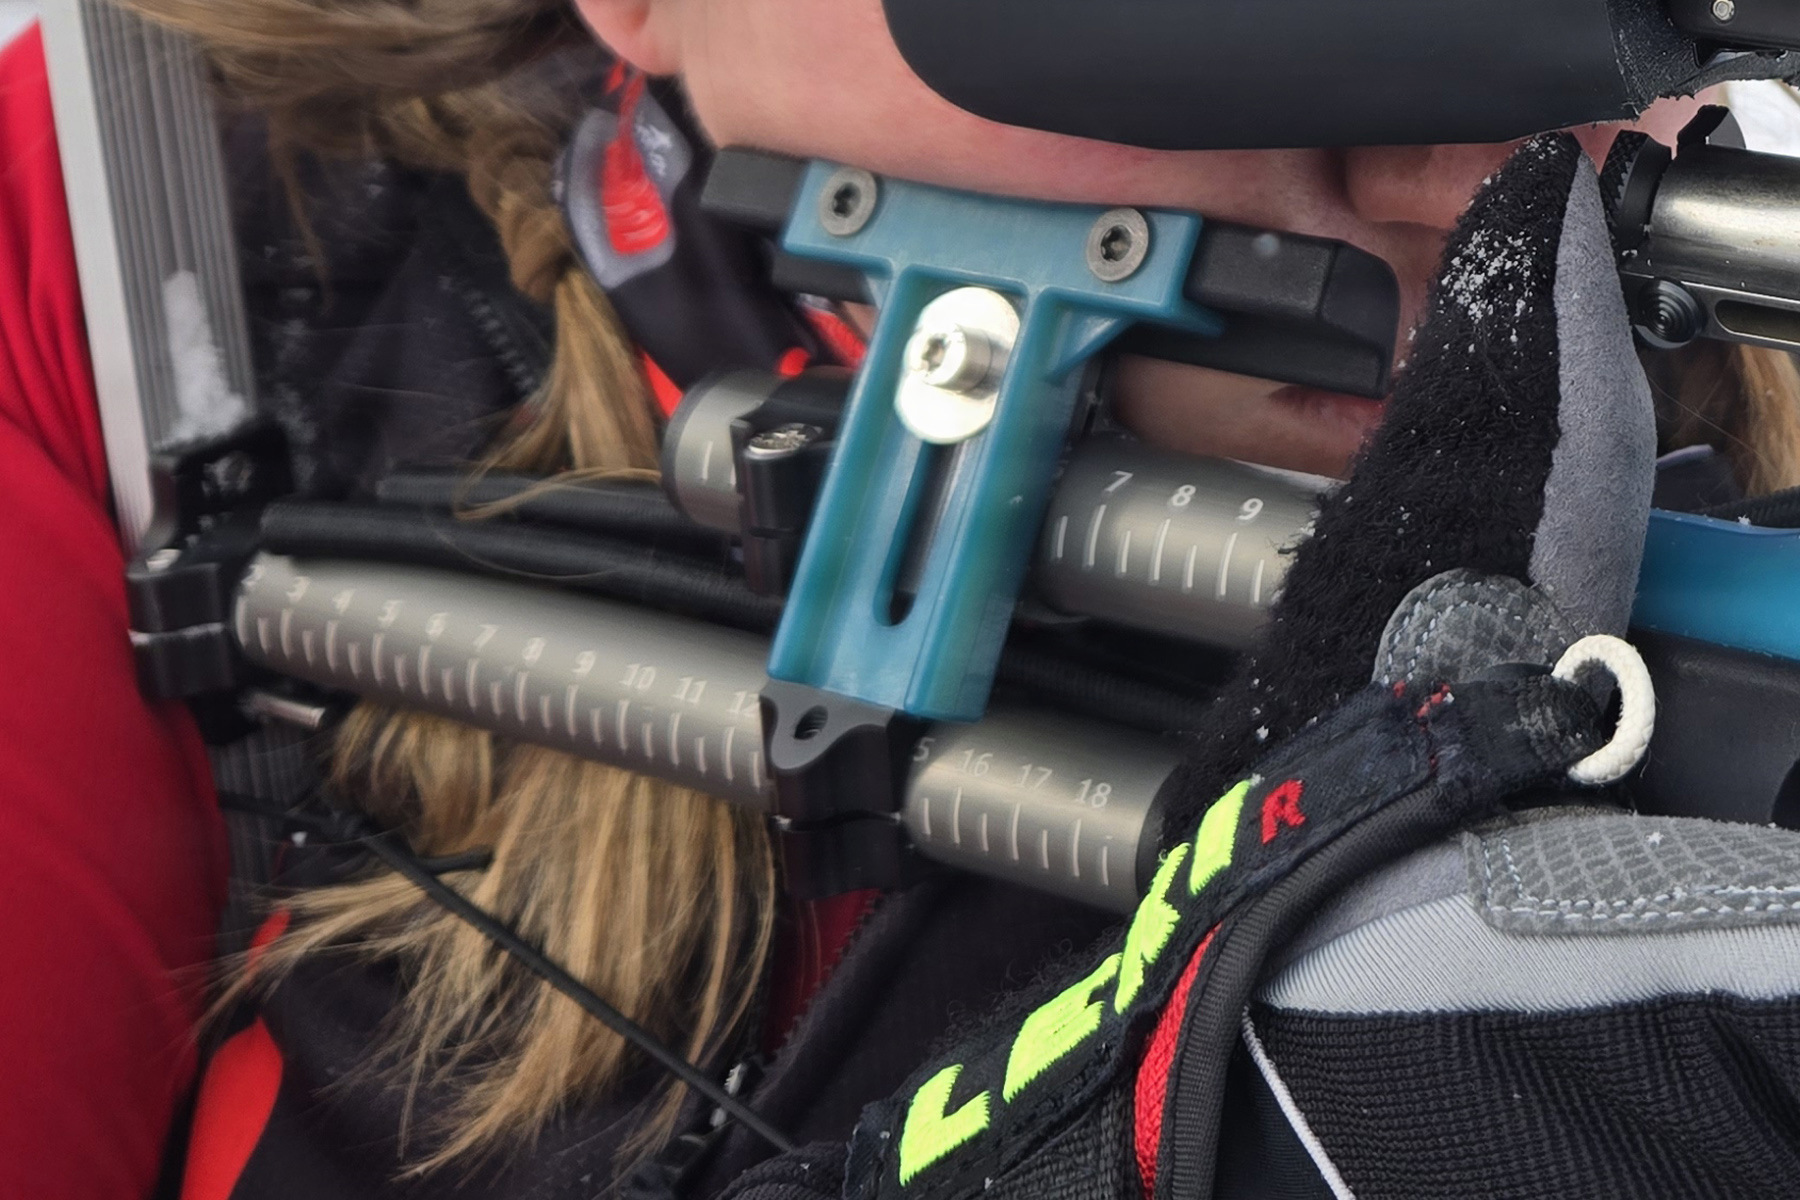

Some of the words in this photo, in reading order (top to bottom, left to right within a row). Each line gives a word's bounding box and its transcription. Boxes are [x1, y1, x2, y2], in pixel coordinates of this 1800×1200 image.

[1105, 470, 1134, 492] 7
[1171, 484, 1197, 507] 8
[1237, 498, 1264, 521] 9
[473, 624, 498, 650] 7
[572, 650, 597, 676] 9
[618, 663, 657, 691] 10
[672, 676, 708, 704] 11
[952, 749, 994, 778] 16
[1012, 763, 1053, 791] 17
[1074, 778, 1112, 809] 18
[1260, 779, 1306, 844] R
